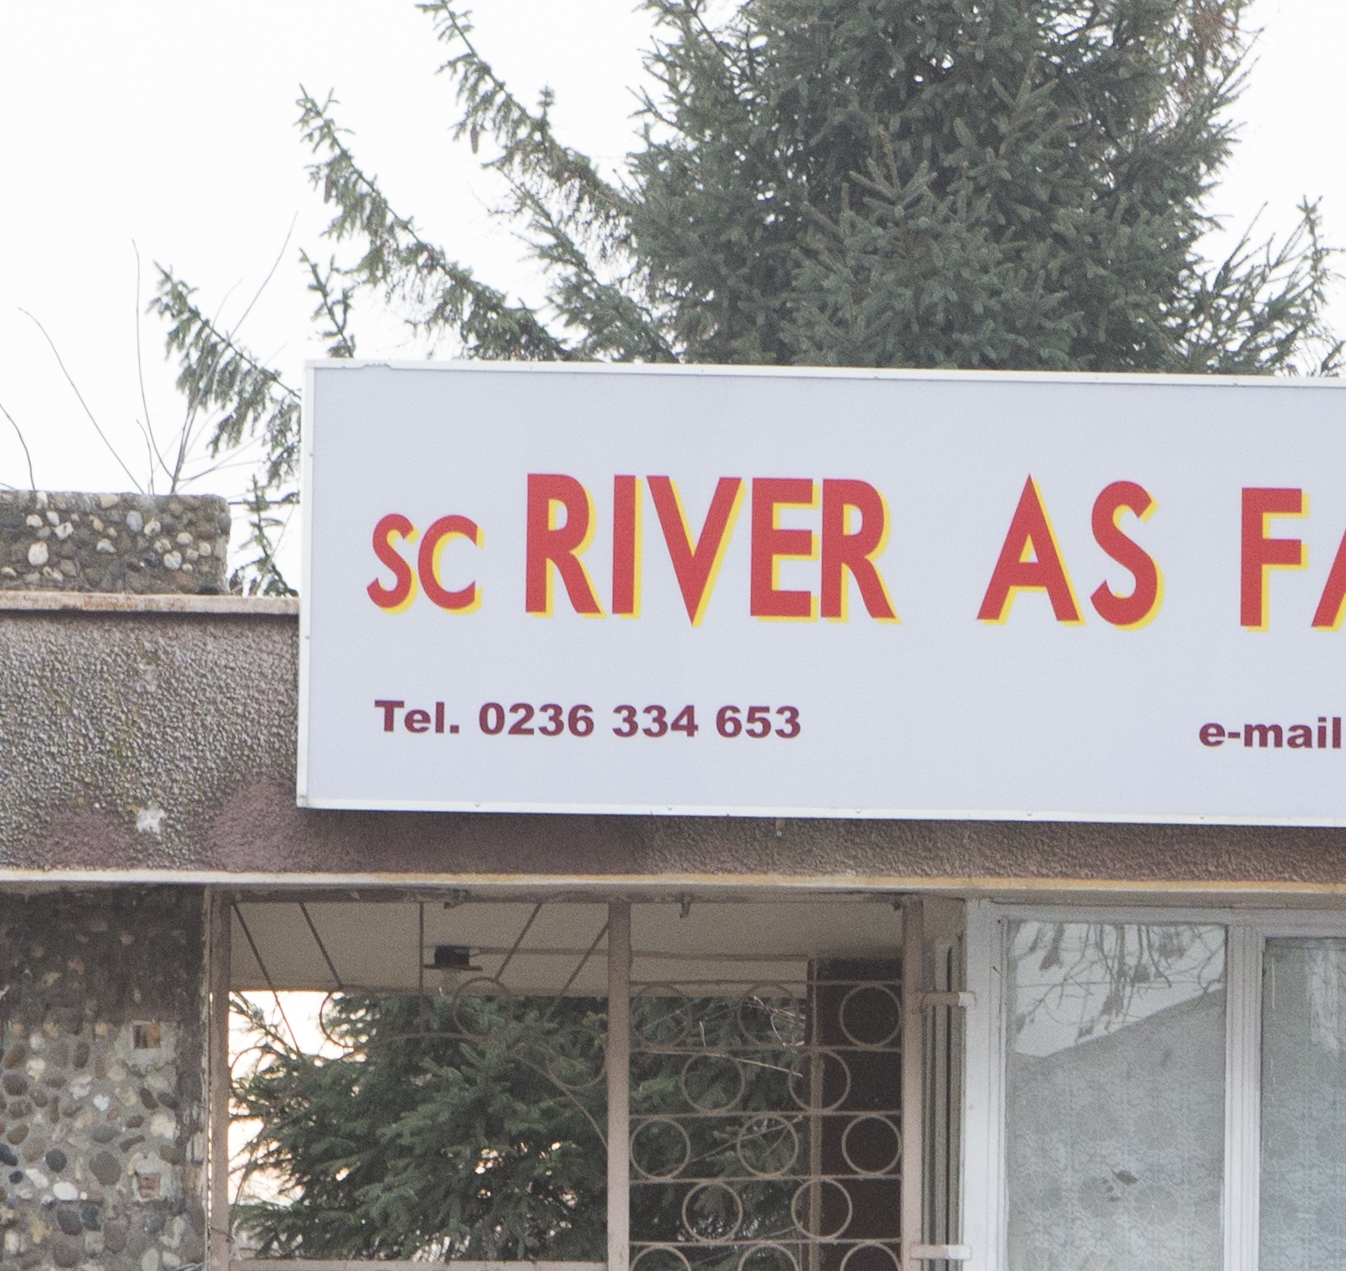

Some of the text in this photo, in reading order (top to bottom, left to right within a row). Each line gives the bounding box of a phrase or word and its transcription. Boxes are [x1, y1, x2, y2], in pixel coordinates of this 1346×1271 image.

[367, 513, 484, 615] SC
[526, 473, 901, 627] RIVER
[977, 473, 1164, 630] AS
[375, 699, 802, 740] Tel. 0236 334 653
